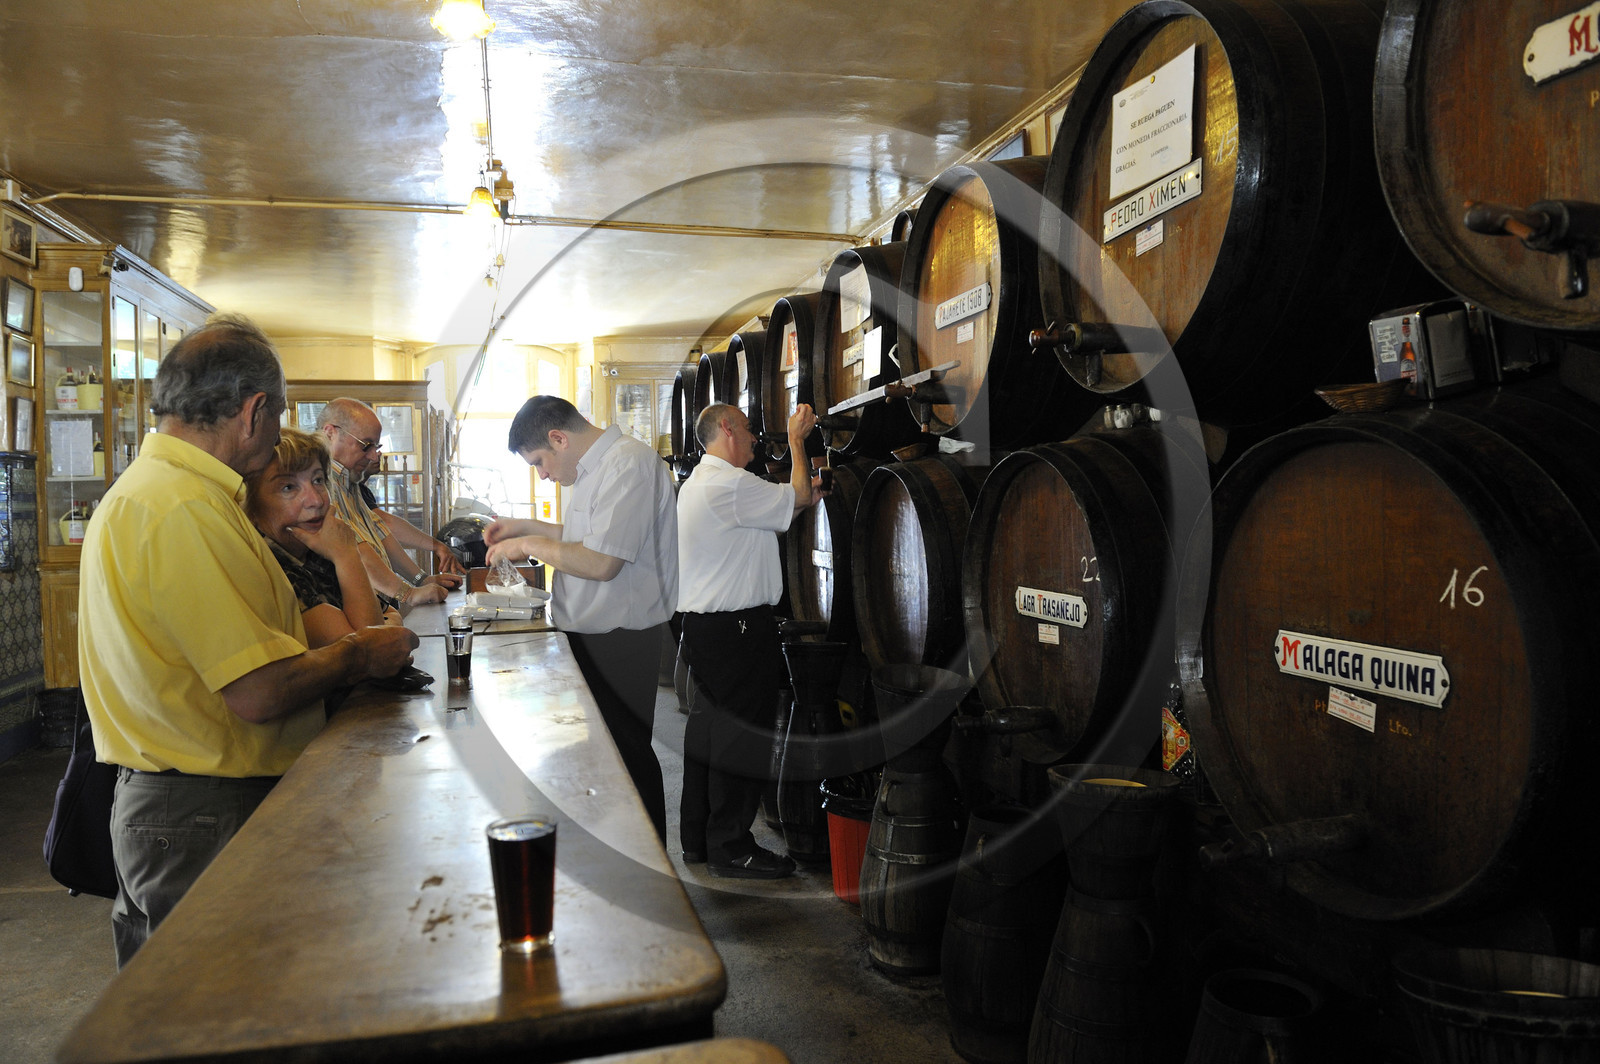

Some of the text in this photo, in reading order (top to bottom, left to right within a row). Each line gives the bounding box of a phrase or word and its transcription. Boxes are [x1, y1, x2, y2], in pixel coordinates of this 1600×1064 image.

[1568, 11, 1600, 56] M
[1116, 112, 1188, 155] CON MONEDA FRACCIONARIA
[1130, 99, 1176, 130] SE RUEGA PAGUEN
[1109, 172, 1187, 232] PEDRO XIMEN
[967, 288, 982, 311] 1908
[1037, 594, 1081, 622] TRASAÑEJO
[1439, 565, 1489, 610] 16
[1281, 636, 1436, 697] MALAGA QUINA
